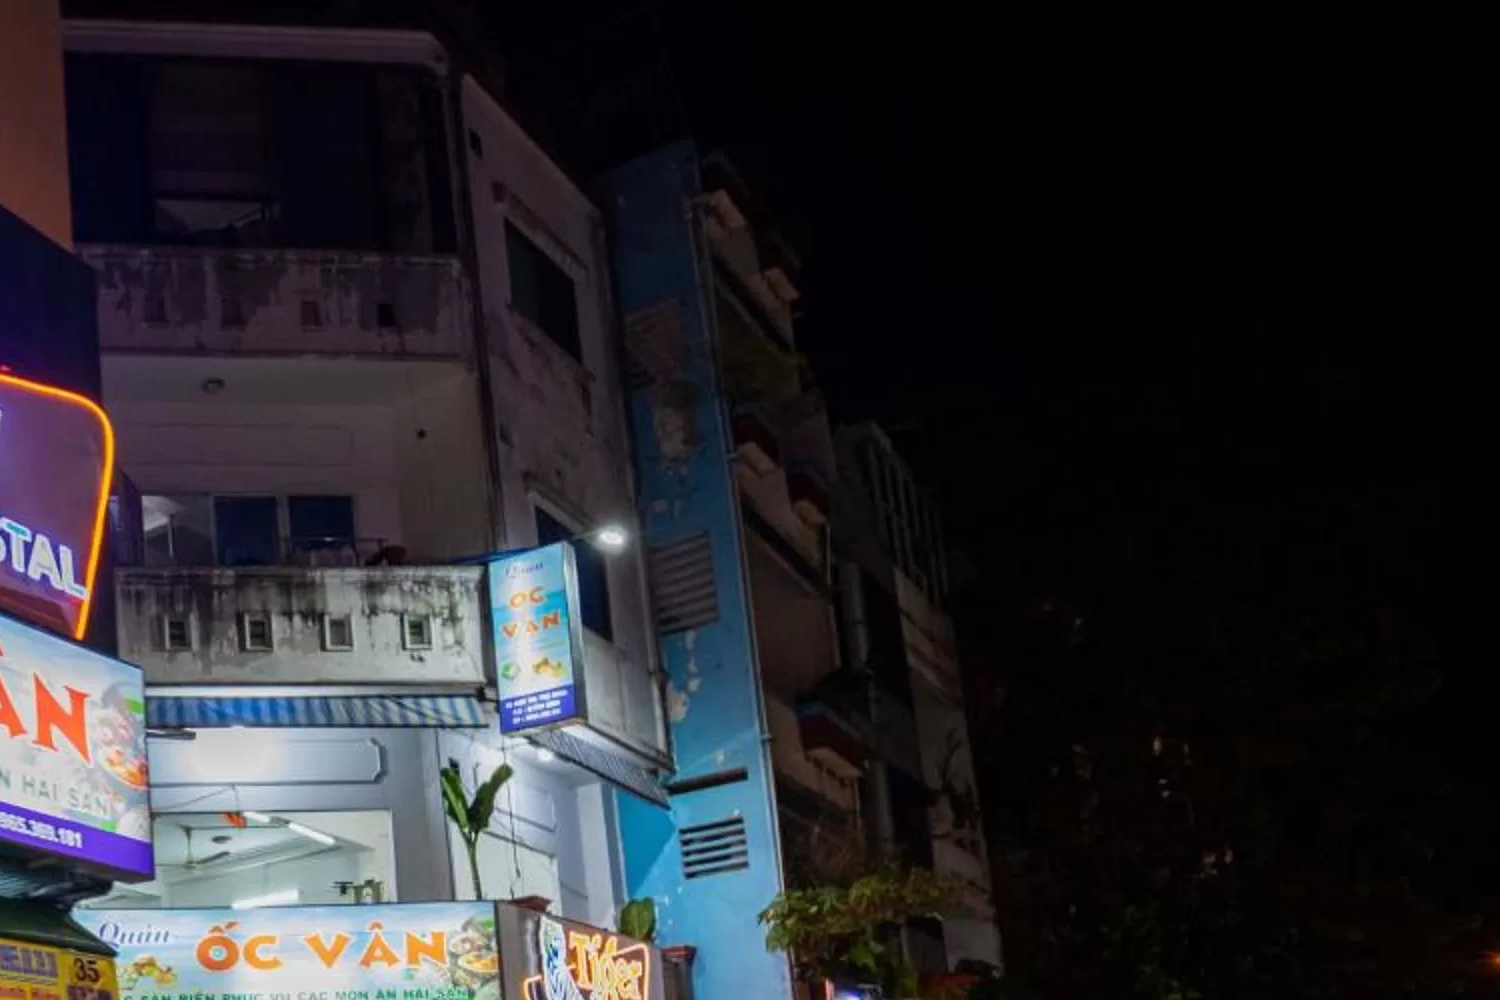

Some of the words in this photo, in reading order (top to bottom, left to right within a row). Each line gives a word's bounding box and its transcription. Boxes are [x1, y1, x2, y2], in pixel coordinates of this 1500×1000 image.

[196, 921, 283, 972] ỐC
[304, 921, 448, 970] VÂN
[73, 957, 100, 983] 35
